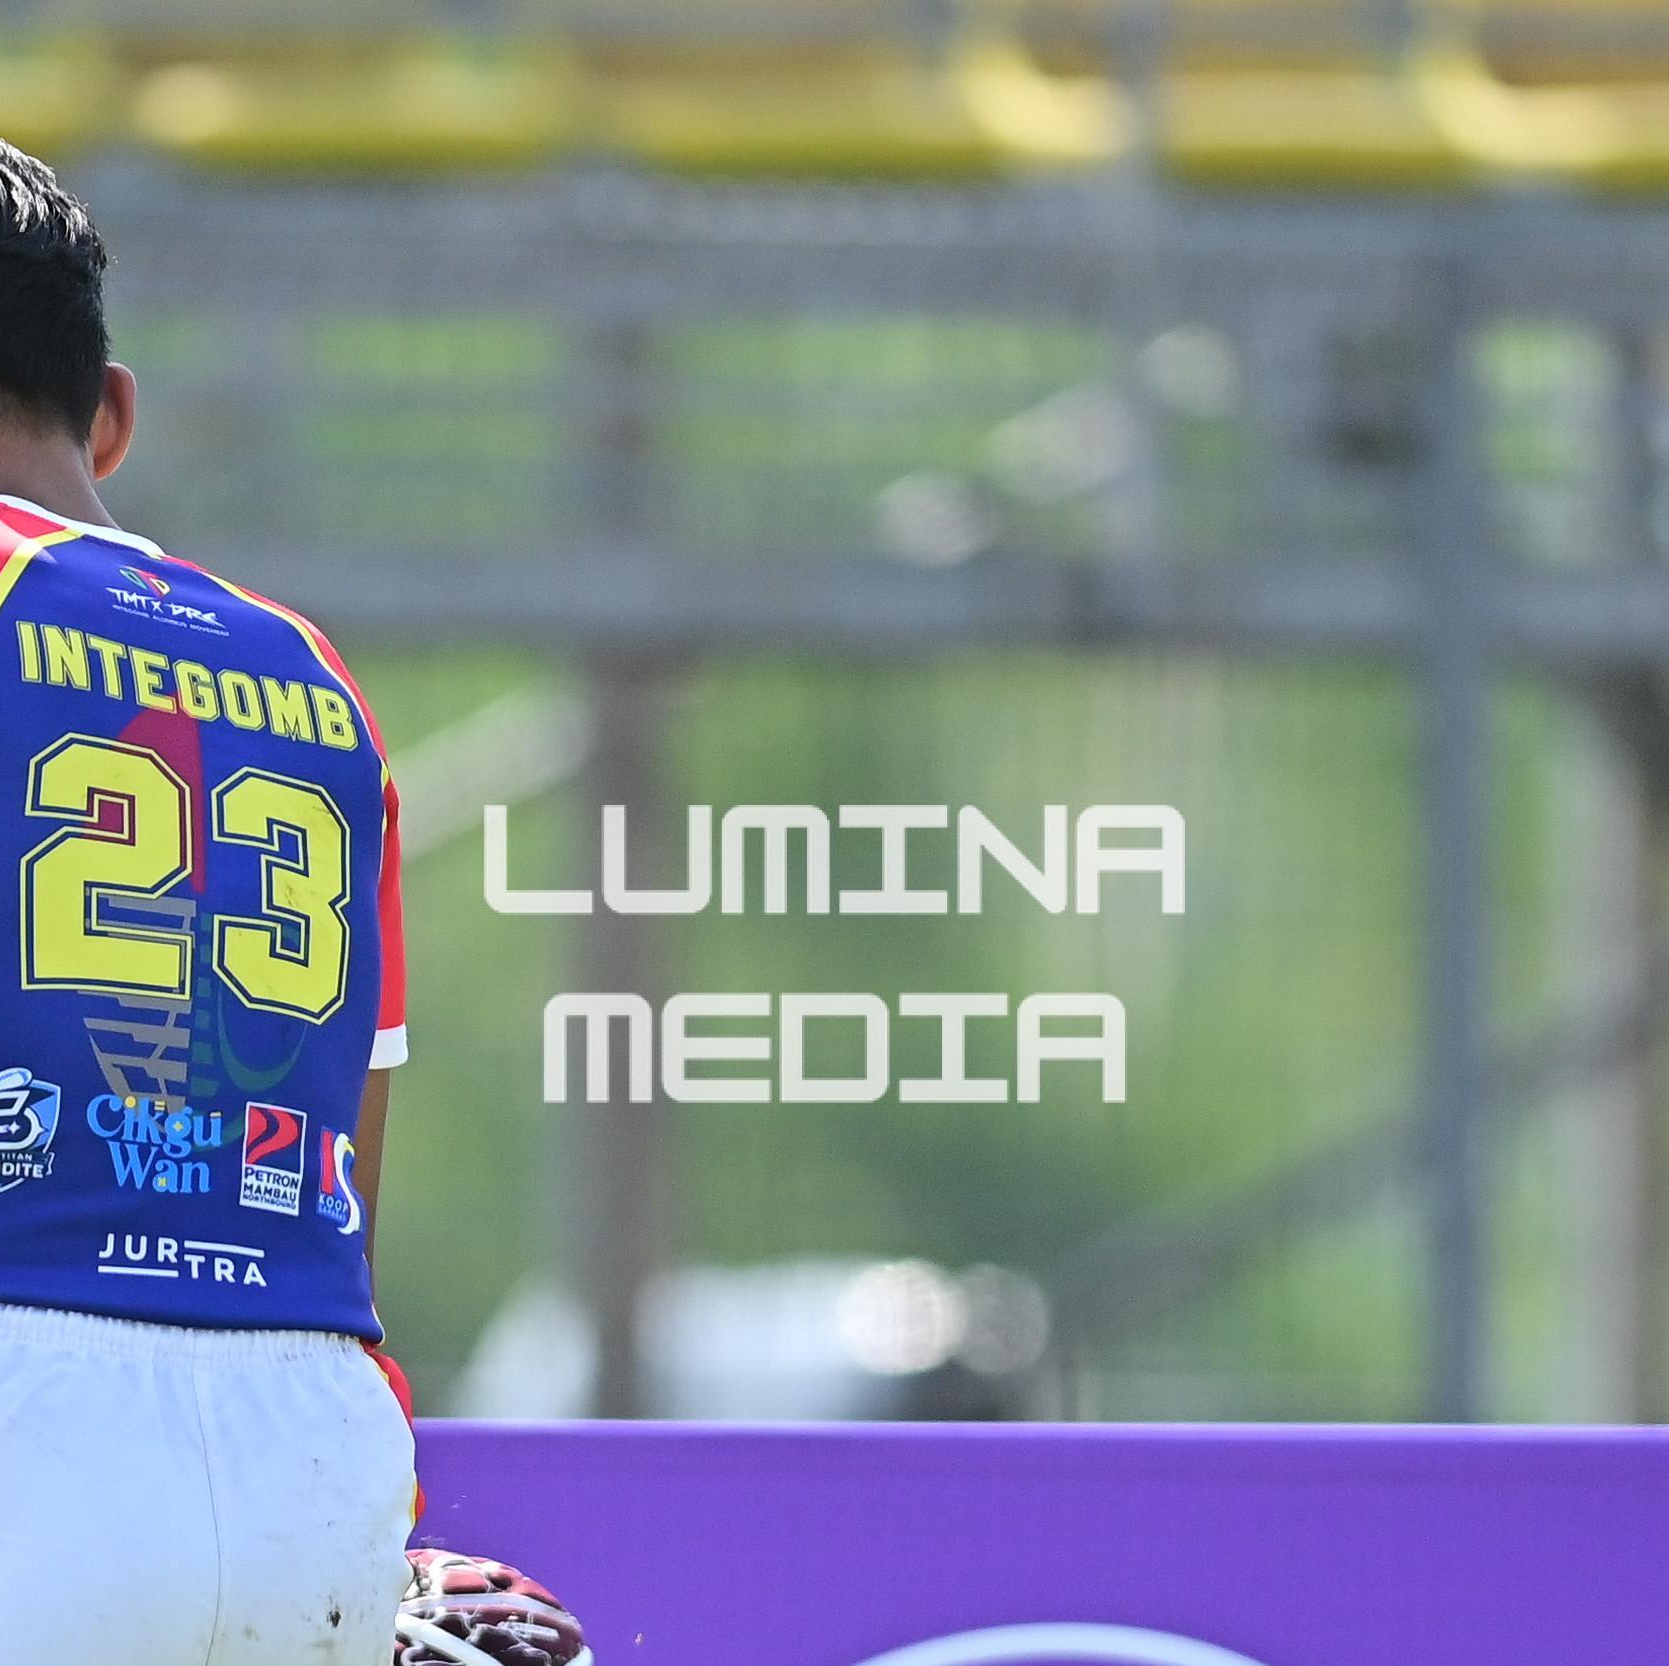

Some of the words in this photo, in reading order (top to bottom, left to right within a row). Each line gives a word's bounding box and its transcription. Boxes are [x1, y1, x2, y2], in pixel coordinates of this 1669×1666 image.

[16, 620, 358, 751] INTEGOMB
[20, 732, 351, 1026] 23
[87, 1094, 222, 1158] Cikgu
[107, 1140, 211, 1194] Wan
[243, 1182, 297, 1203] MAMBAU
[244, 1167, 300, 1190] PETRON
